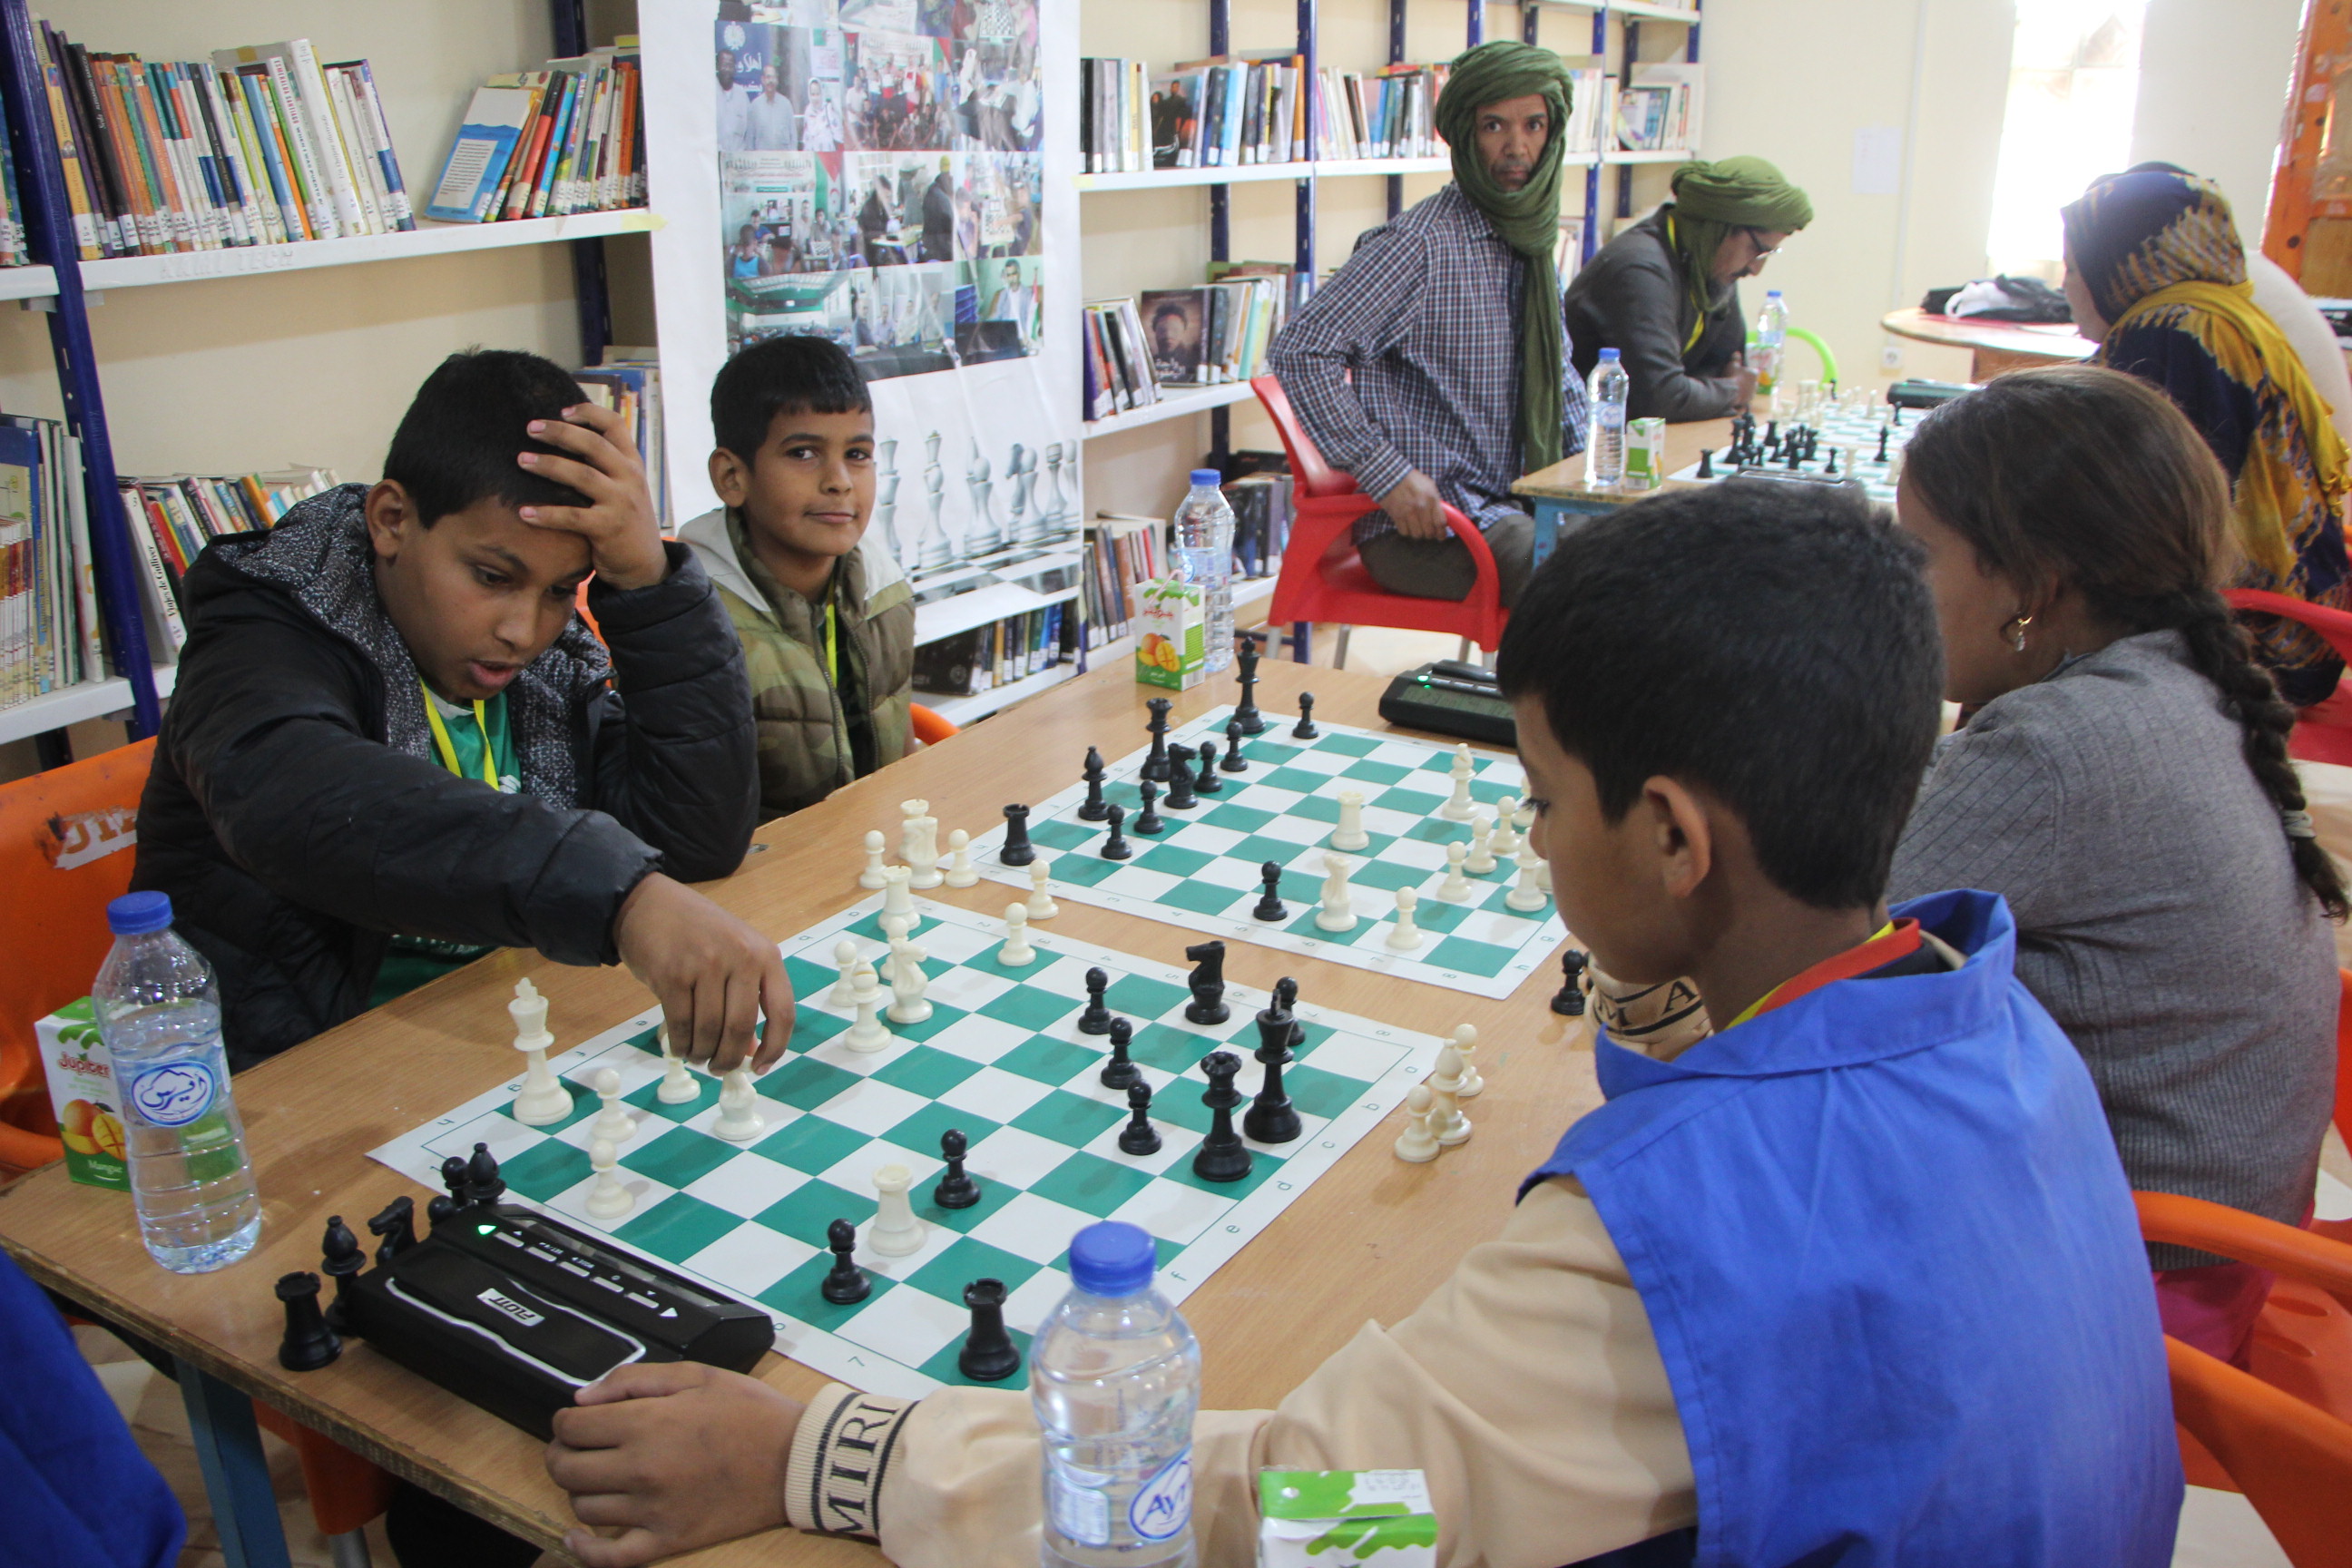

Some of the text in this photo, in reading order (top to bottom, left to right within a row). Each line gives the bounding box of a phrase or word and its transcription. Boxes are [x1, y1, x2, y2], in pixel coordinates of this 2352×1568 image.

[274, 60, 290, 94] ESMERALDA
[285, 95, 299, 124] SANTIAGO
[296, 127, 306, 147] WHEN
[304, 152, 312, 169] WAS
[309, 170, 320, 197] PUERTO
[148, 544, 163, 579] Gulliver
[159, 580, 168, 591] de
[163, 591, 177, 617] Viajes
[57, 1052, 111, 1078] Jupiter
[1171, 1270, 1187, 1281] f
[1226, 1225, 1240, 1234] e
[1277, 1181, 1292, 1191] d
[1361, 1102, 1379, 1112] b
